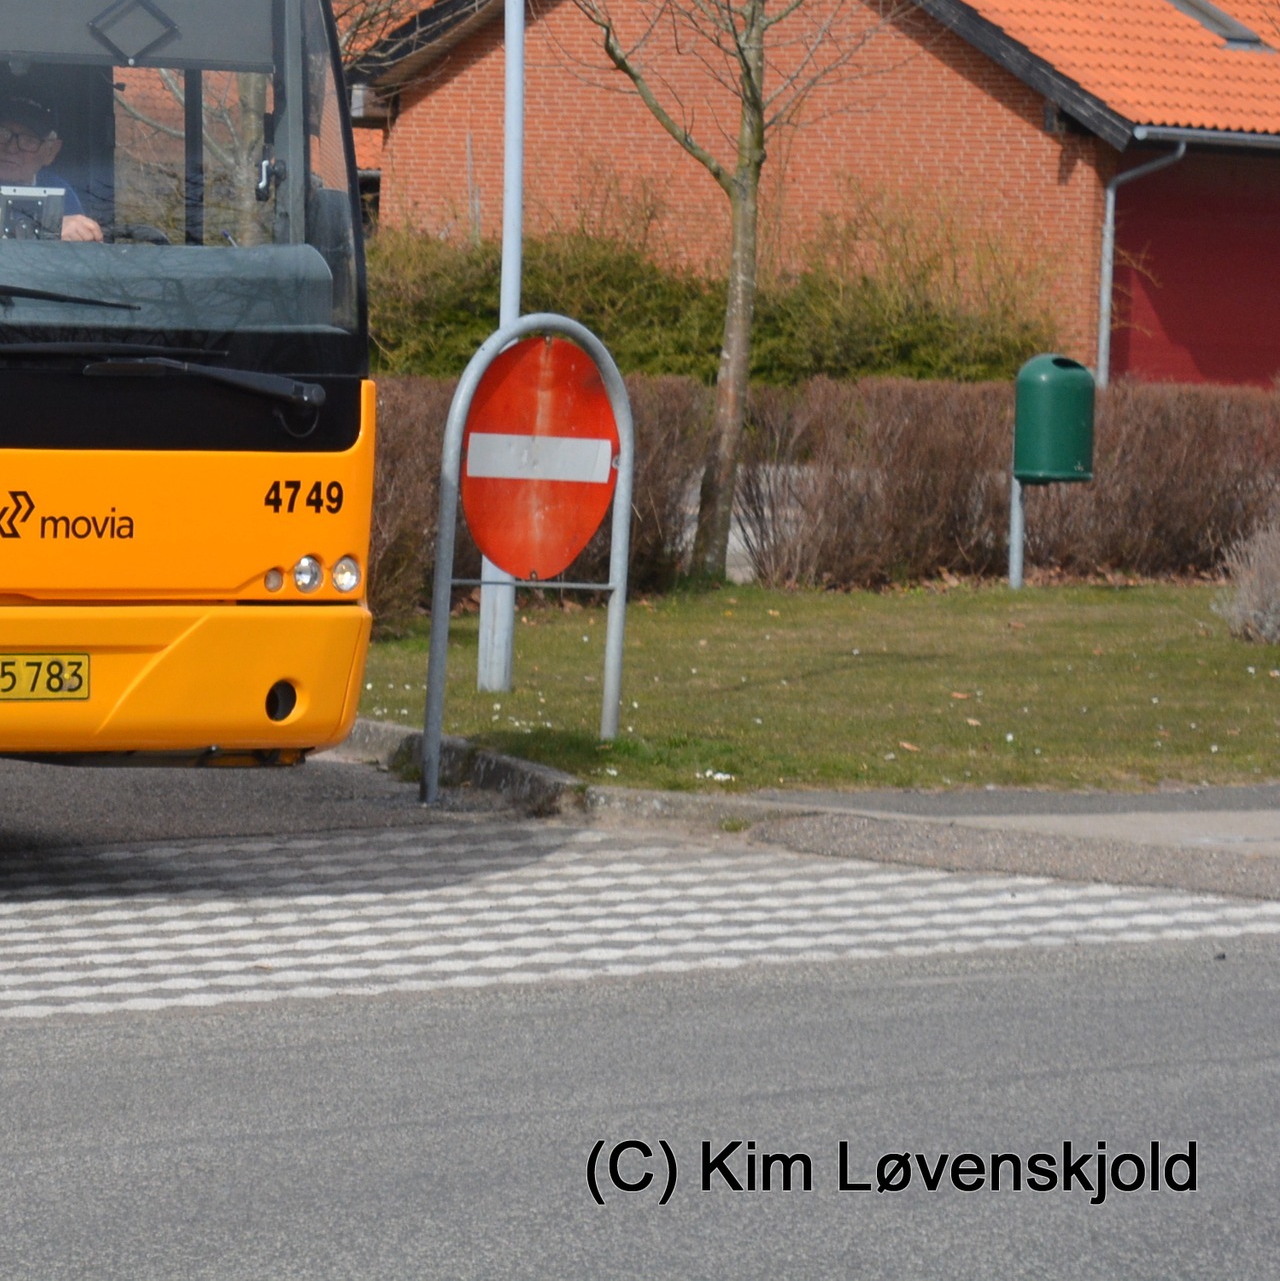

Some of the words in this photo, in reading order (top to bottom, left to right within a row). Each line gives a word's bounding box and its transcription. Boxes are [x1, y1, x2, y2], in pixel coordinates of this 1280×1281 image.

[264, 480, 344, 514] 4749
[40, 507, 134, 539] movia
[25, 661, 83, 693] 783
